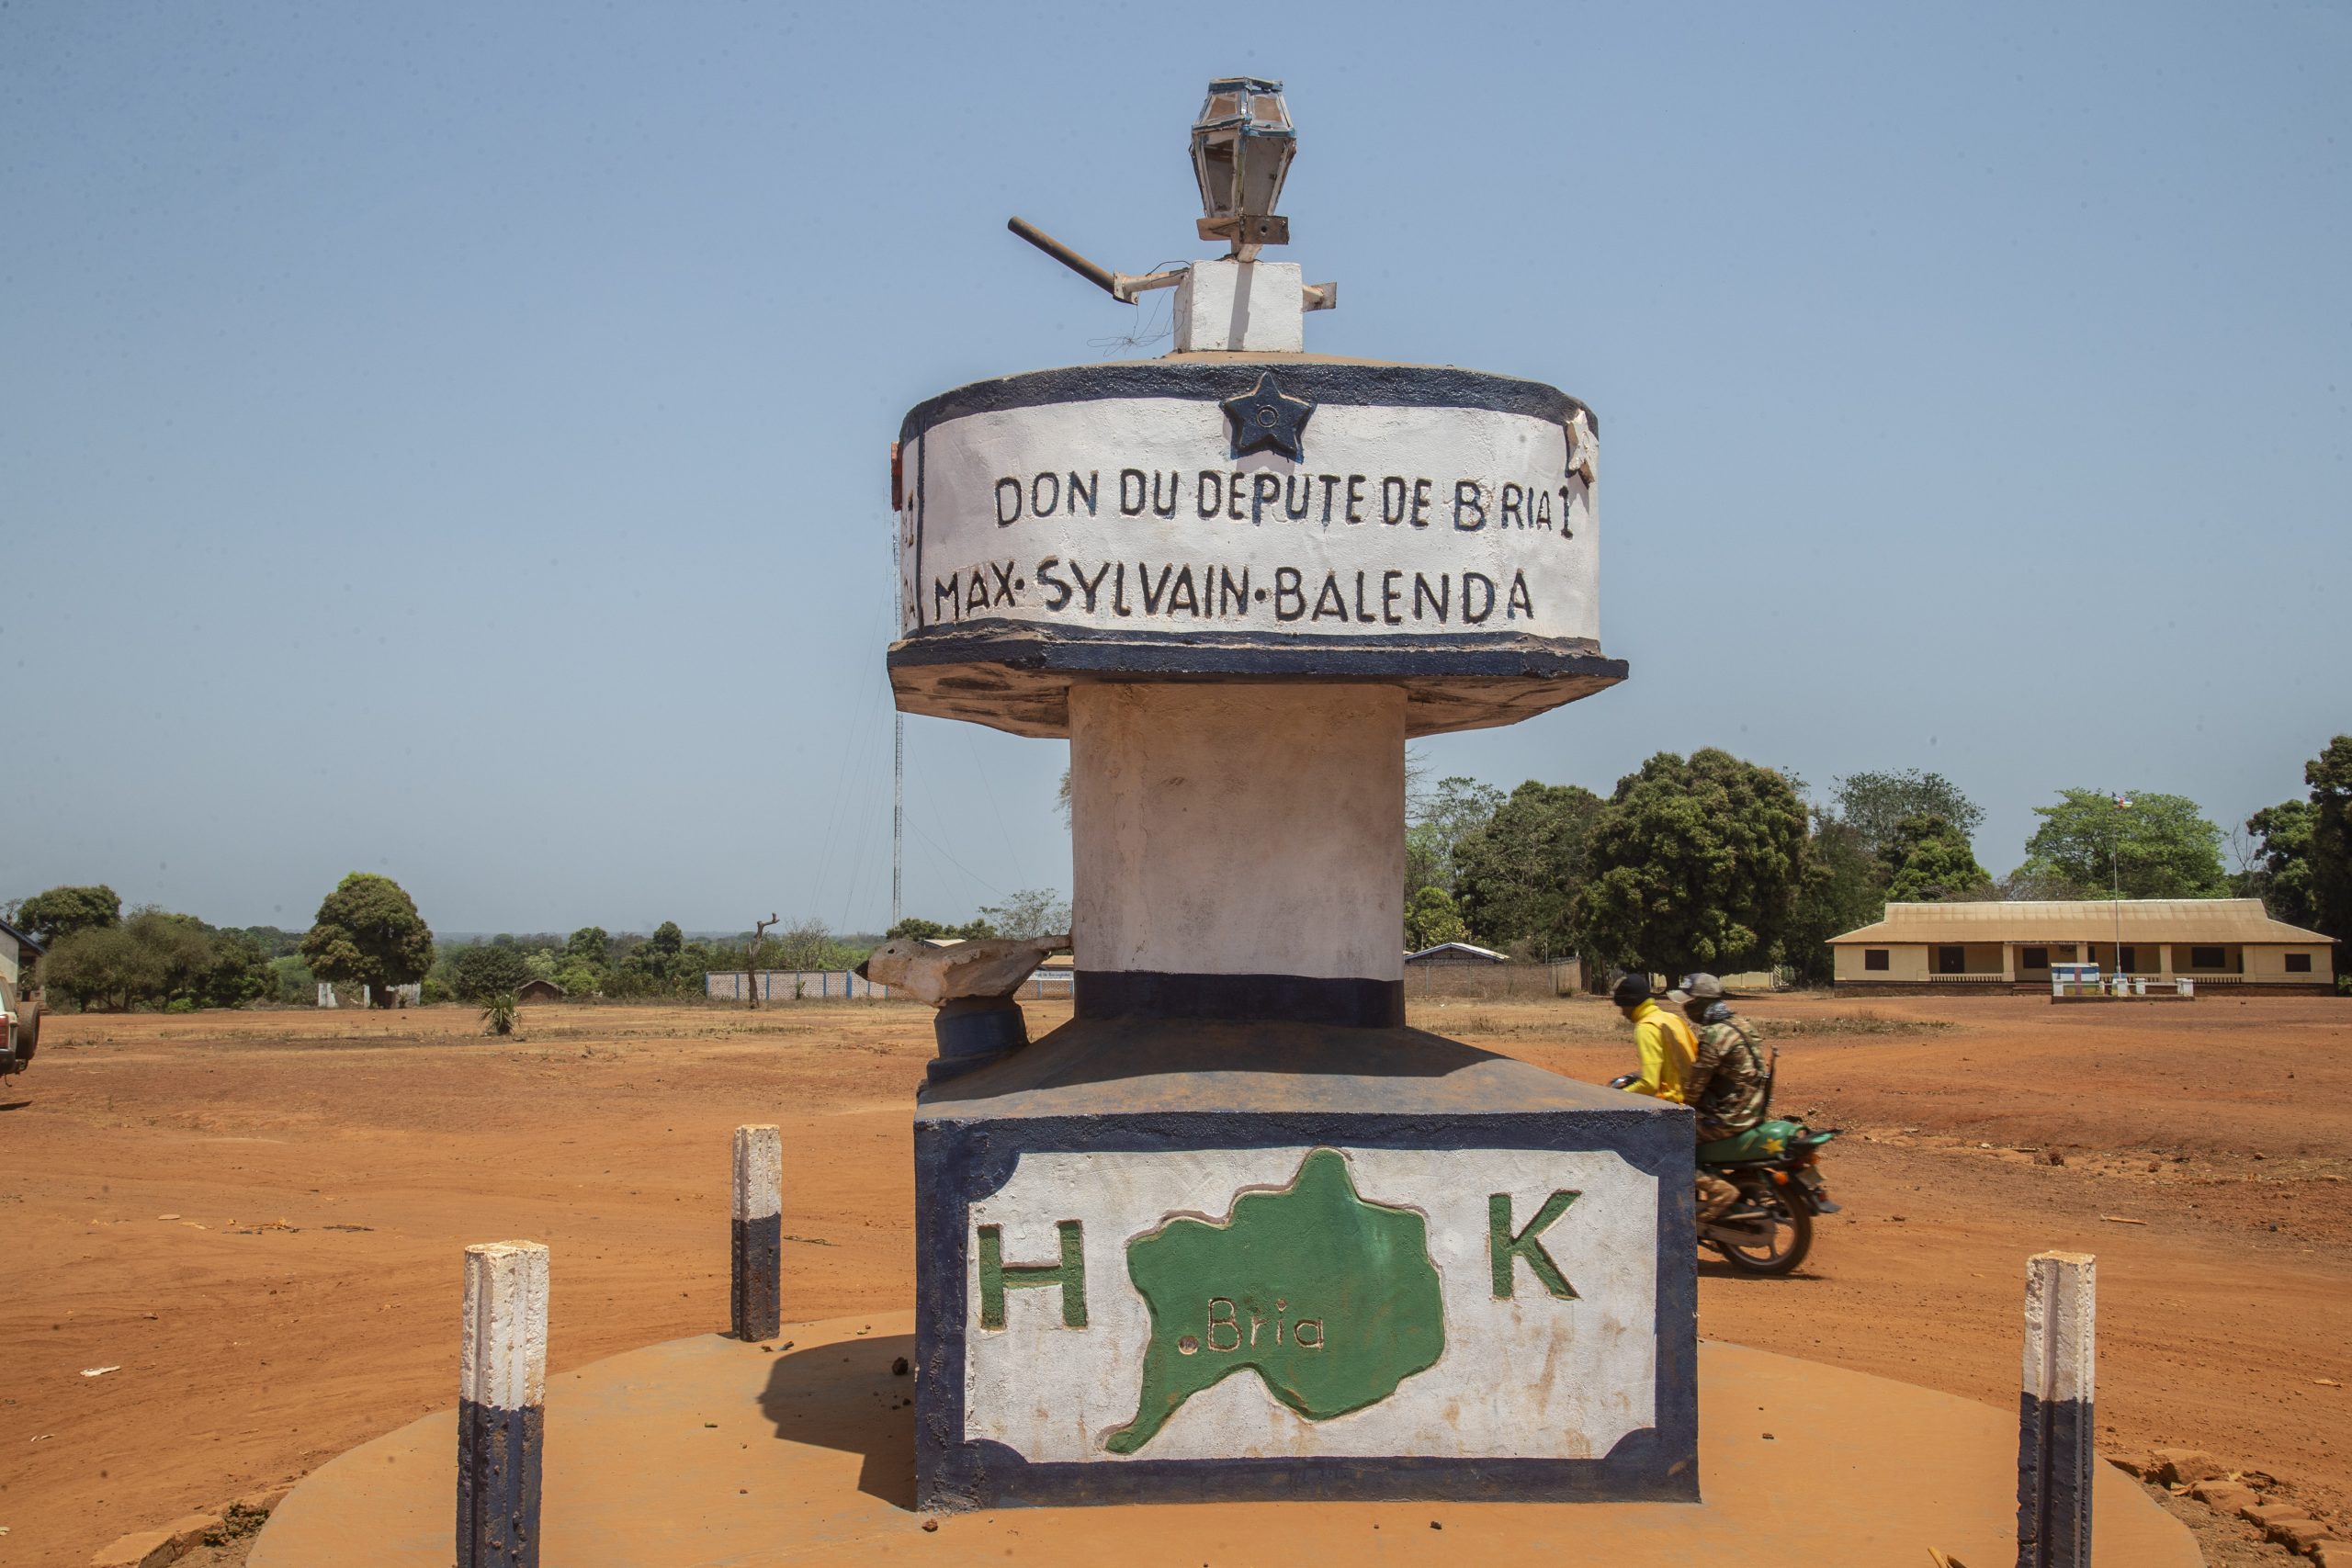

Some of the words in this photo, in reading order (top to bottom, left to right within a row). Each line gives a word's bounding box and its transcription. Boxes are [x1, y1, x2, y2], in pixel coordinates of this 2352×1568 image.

[995, 469, 1098, 528] DON
[1120, 468, 1178, 518] DU
[1198, 469, 1366, 526] DEPUTE
[1383, 476, 1432, 527] DE
[1275, 567, 1533, 625] BALENDA
[978, 1219, 1088, 1331] H
[1488, 1189, 1581, 1301] K
[1208, 1296, 1324, 1350] Bria
